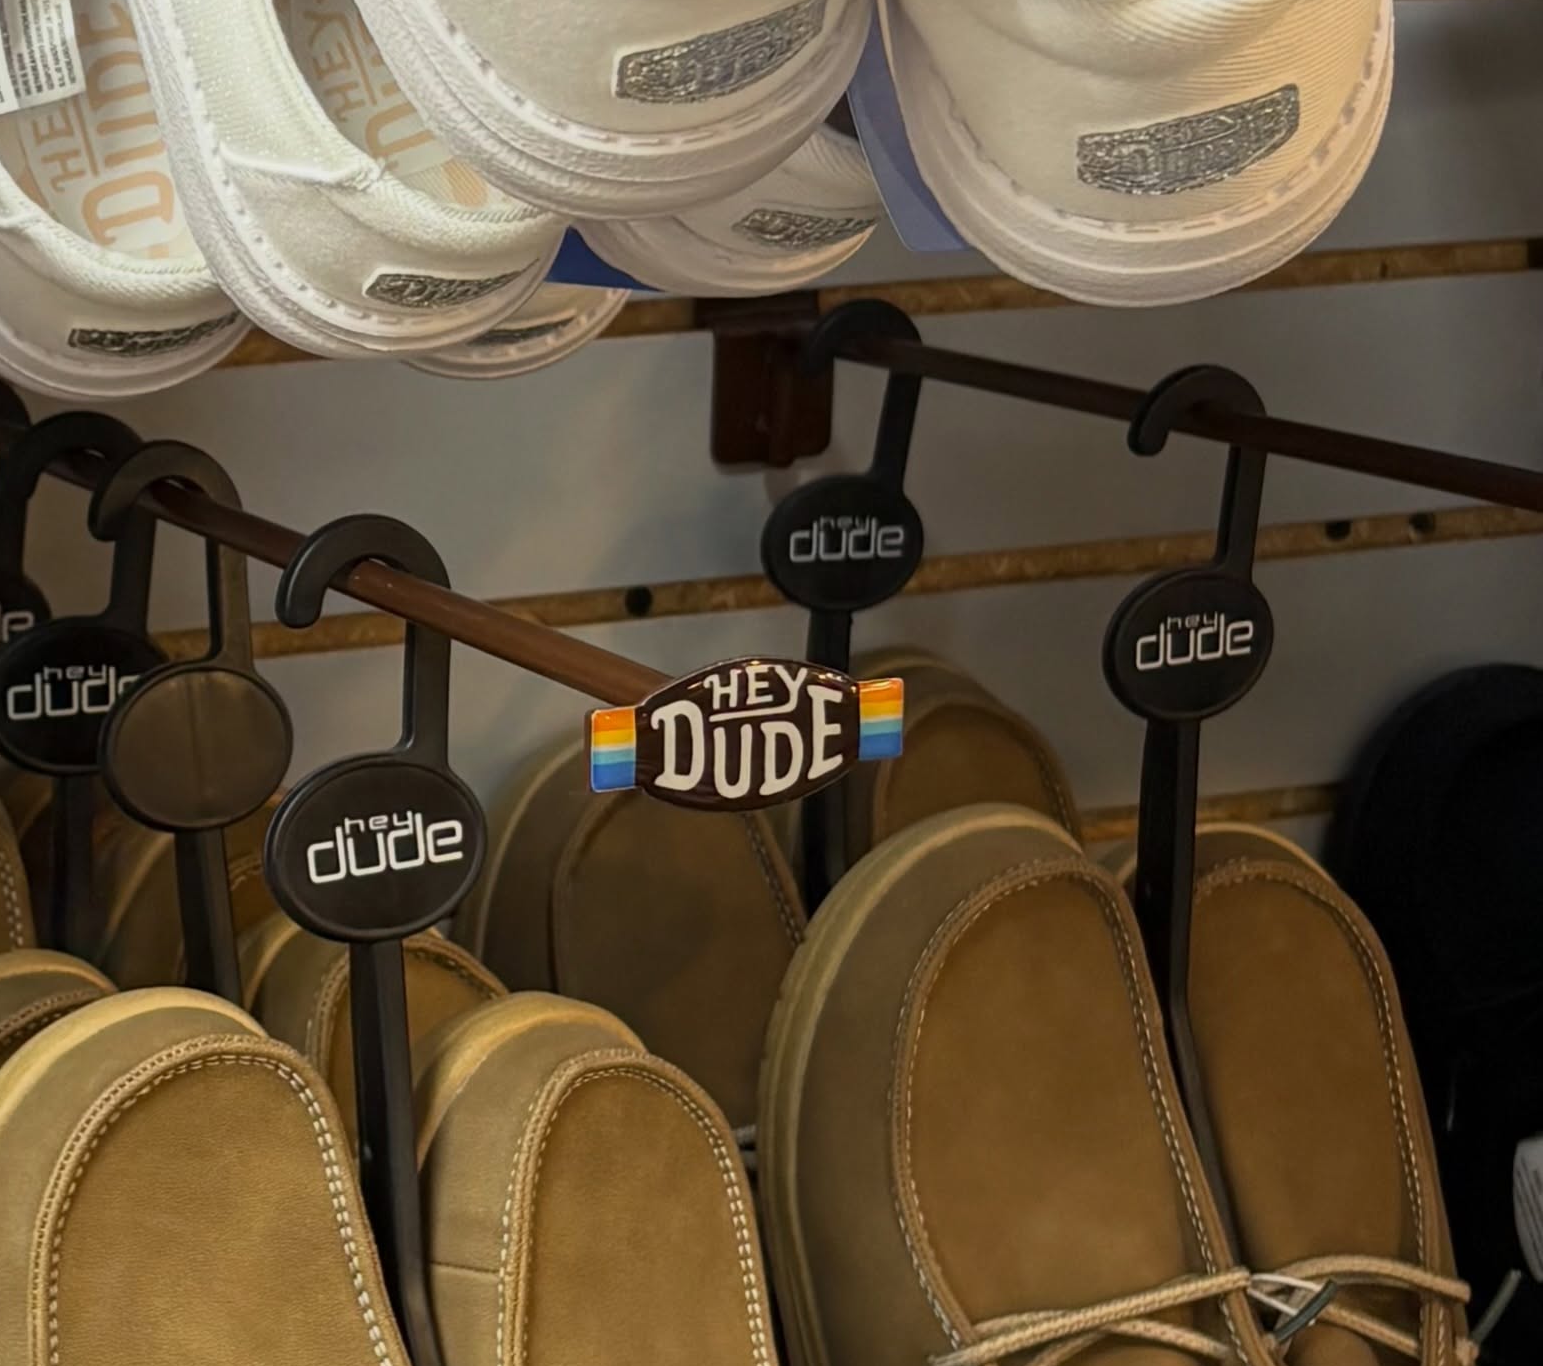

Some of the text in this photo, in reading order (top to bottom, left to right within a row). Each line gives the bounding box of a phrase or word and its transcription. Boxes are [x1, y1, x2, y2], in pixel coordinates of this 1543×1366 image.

[789, 515, 905, 564] dude
[1135, 612, 1255, 672] dude
[1165, 611, 1220, 631] hey
[42, 662, 110, 683] hey
[702, 663, 811, 718] HEY
[651, 683, 845, 800] DUDE
[343, 810, 415, 834] hey
[306, 813, 464, 885] dude
